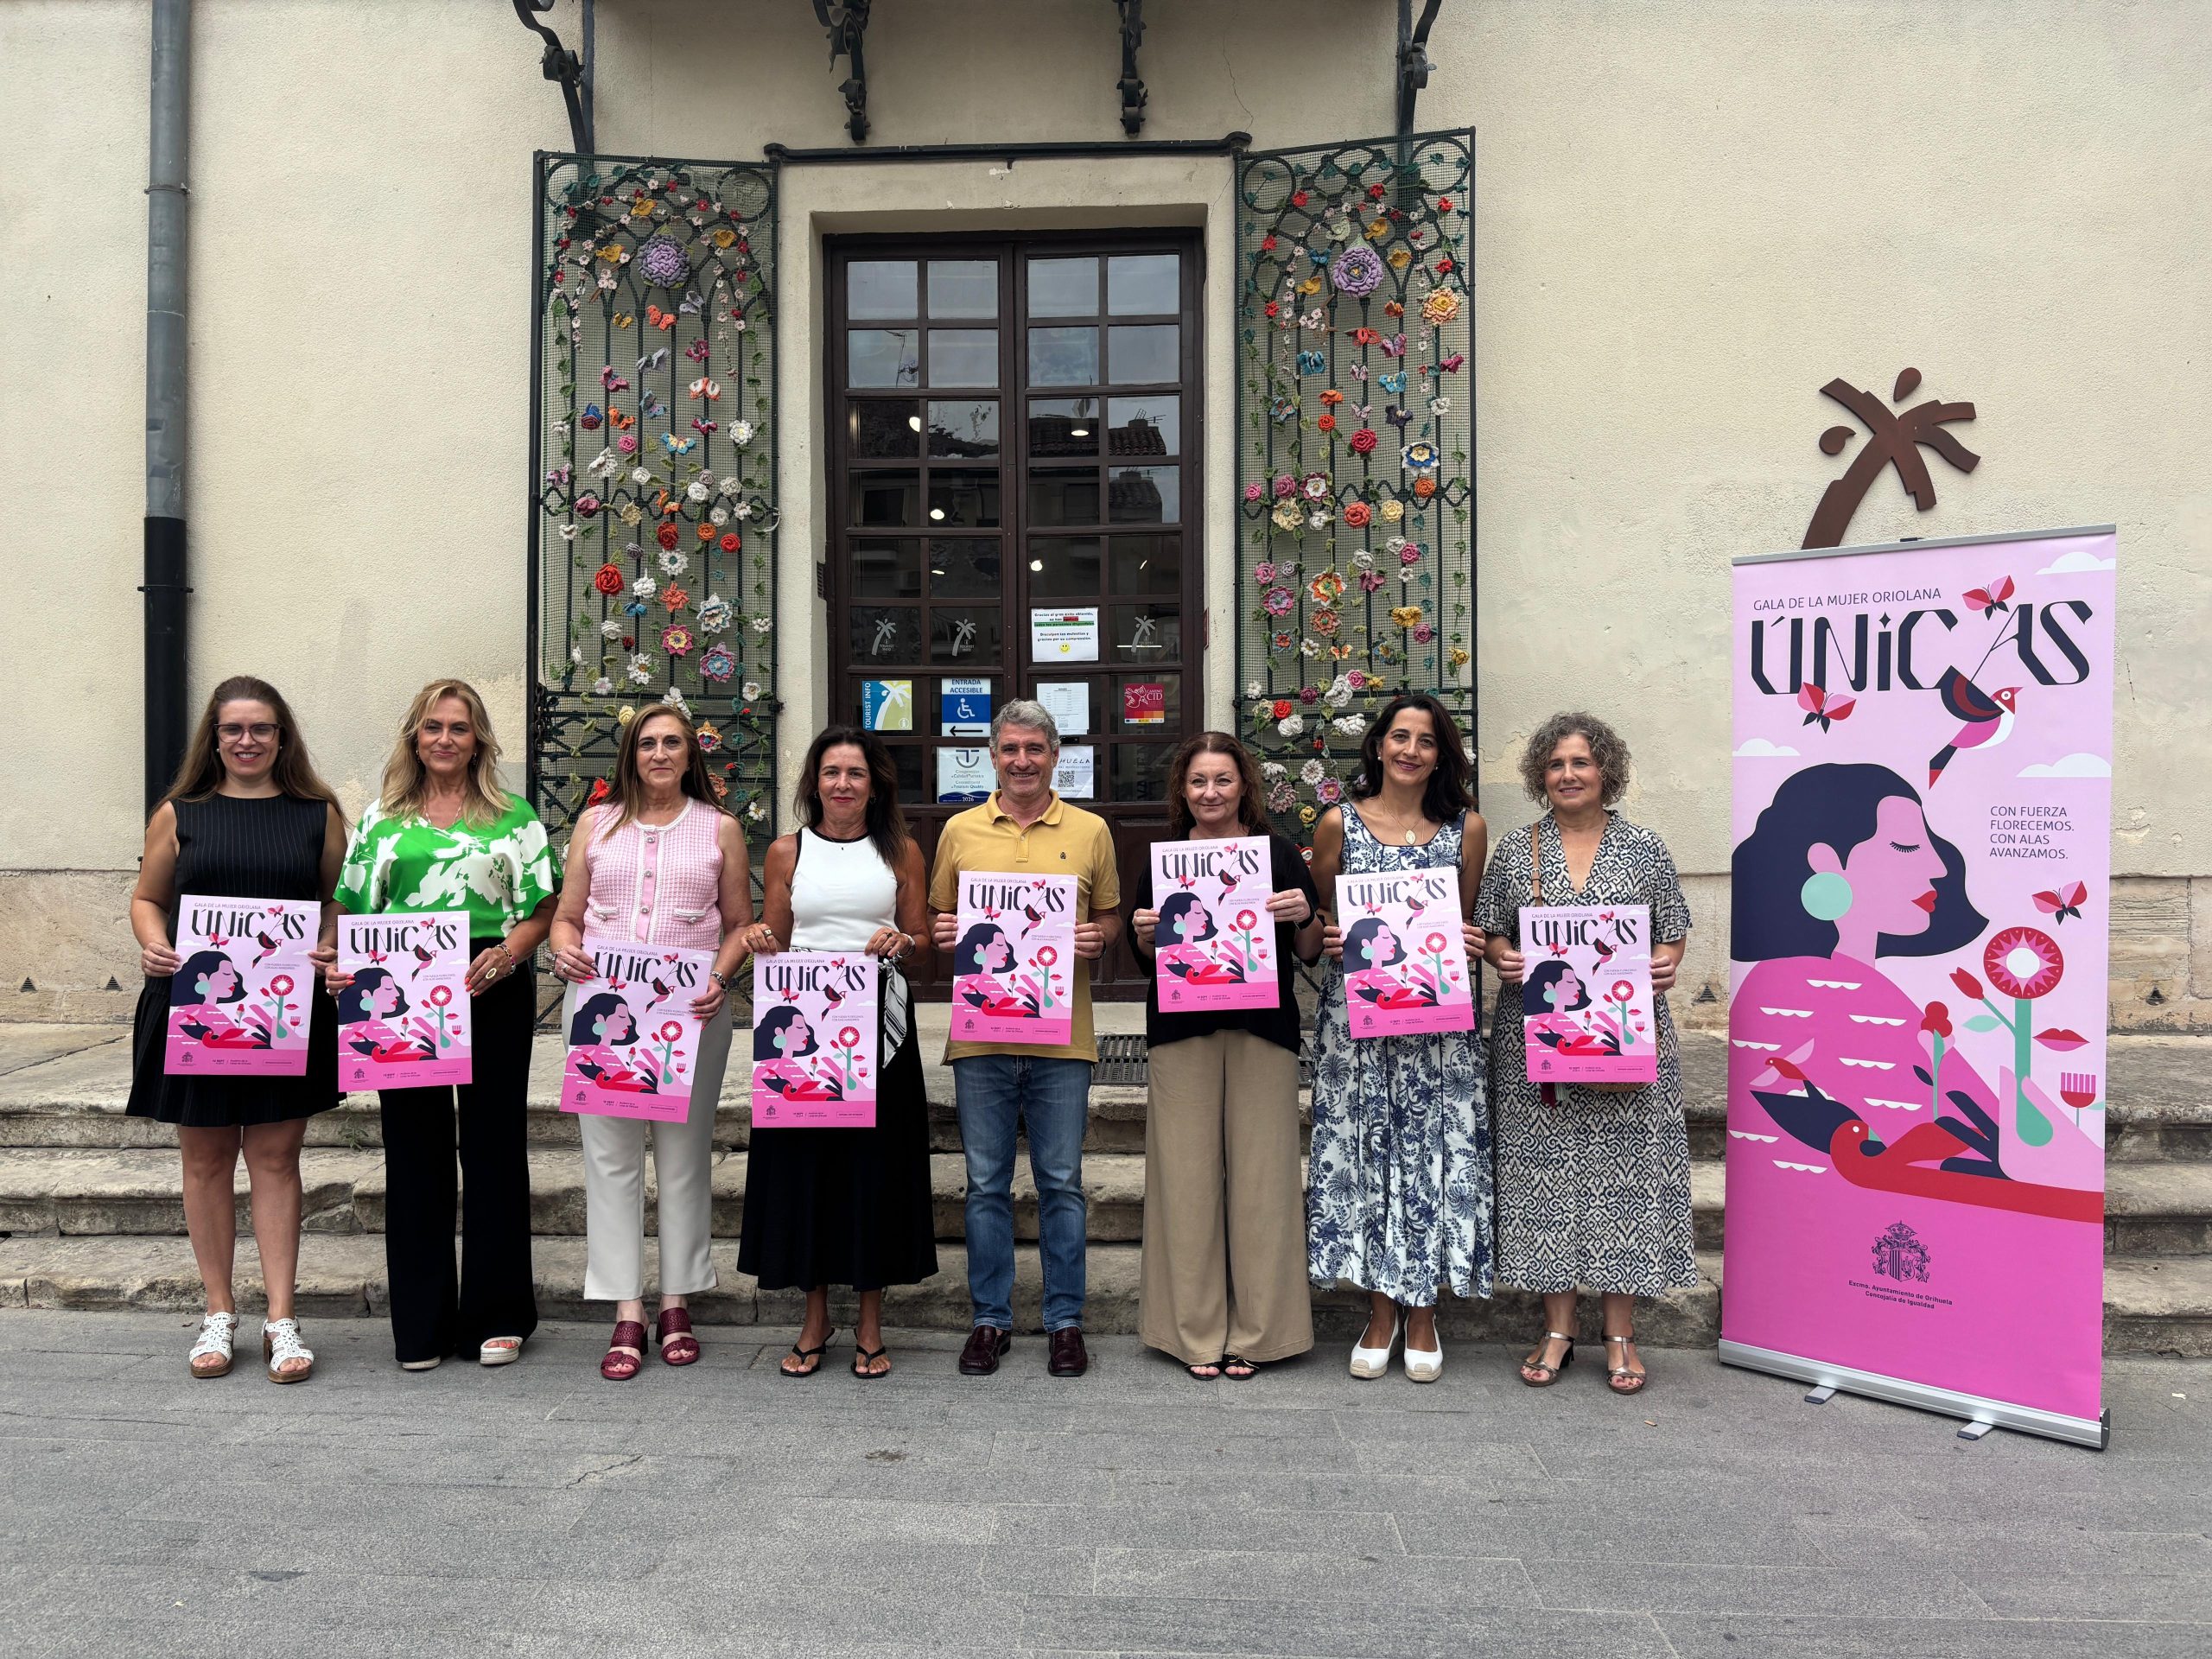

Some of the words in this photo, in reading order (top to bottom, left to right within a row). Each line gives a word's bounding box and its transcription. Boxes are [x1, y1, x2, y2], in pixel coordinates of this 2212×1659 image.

[1753, 599, 1785, 611] GALA
[1788, 597, 1804, 608] DE
[1808, 596, 1823, 607] LA
[1827, 593, 1868, 607] MUJER
[1872, 588, 1942, 603] ORIOLANA
[1990, 806, 2017, 817] CON
[2020, 806, 2068, 817] FUERZA
[1990, 820, 2075, 831] FLORECEMOS.
[1990, 833, 2016, 844] CON
[2019, 834, 2050, 845] ALAS
[1989, 847, 2069, 859] AVANZAMOS.
[1848, 1280, 1871, 1289] Excmo.
[1872, 1285, 1914, 1298] Ayuntamiento
[1925, 1294, 1953, 1306] Orihuela
[1907, 1299, 1935, 1309] Igualdad
